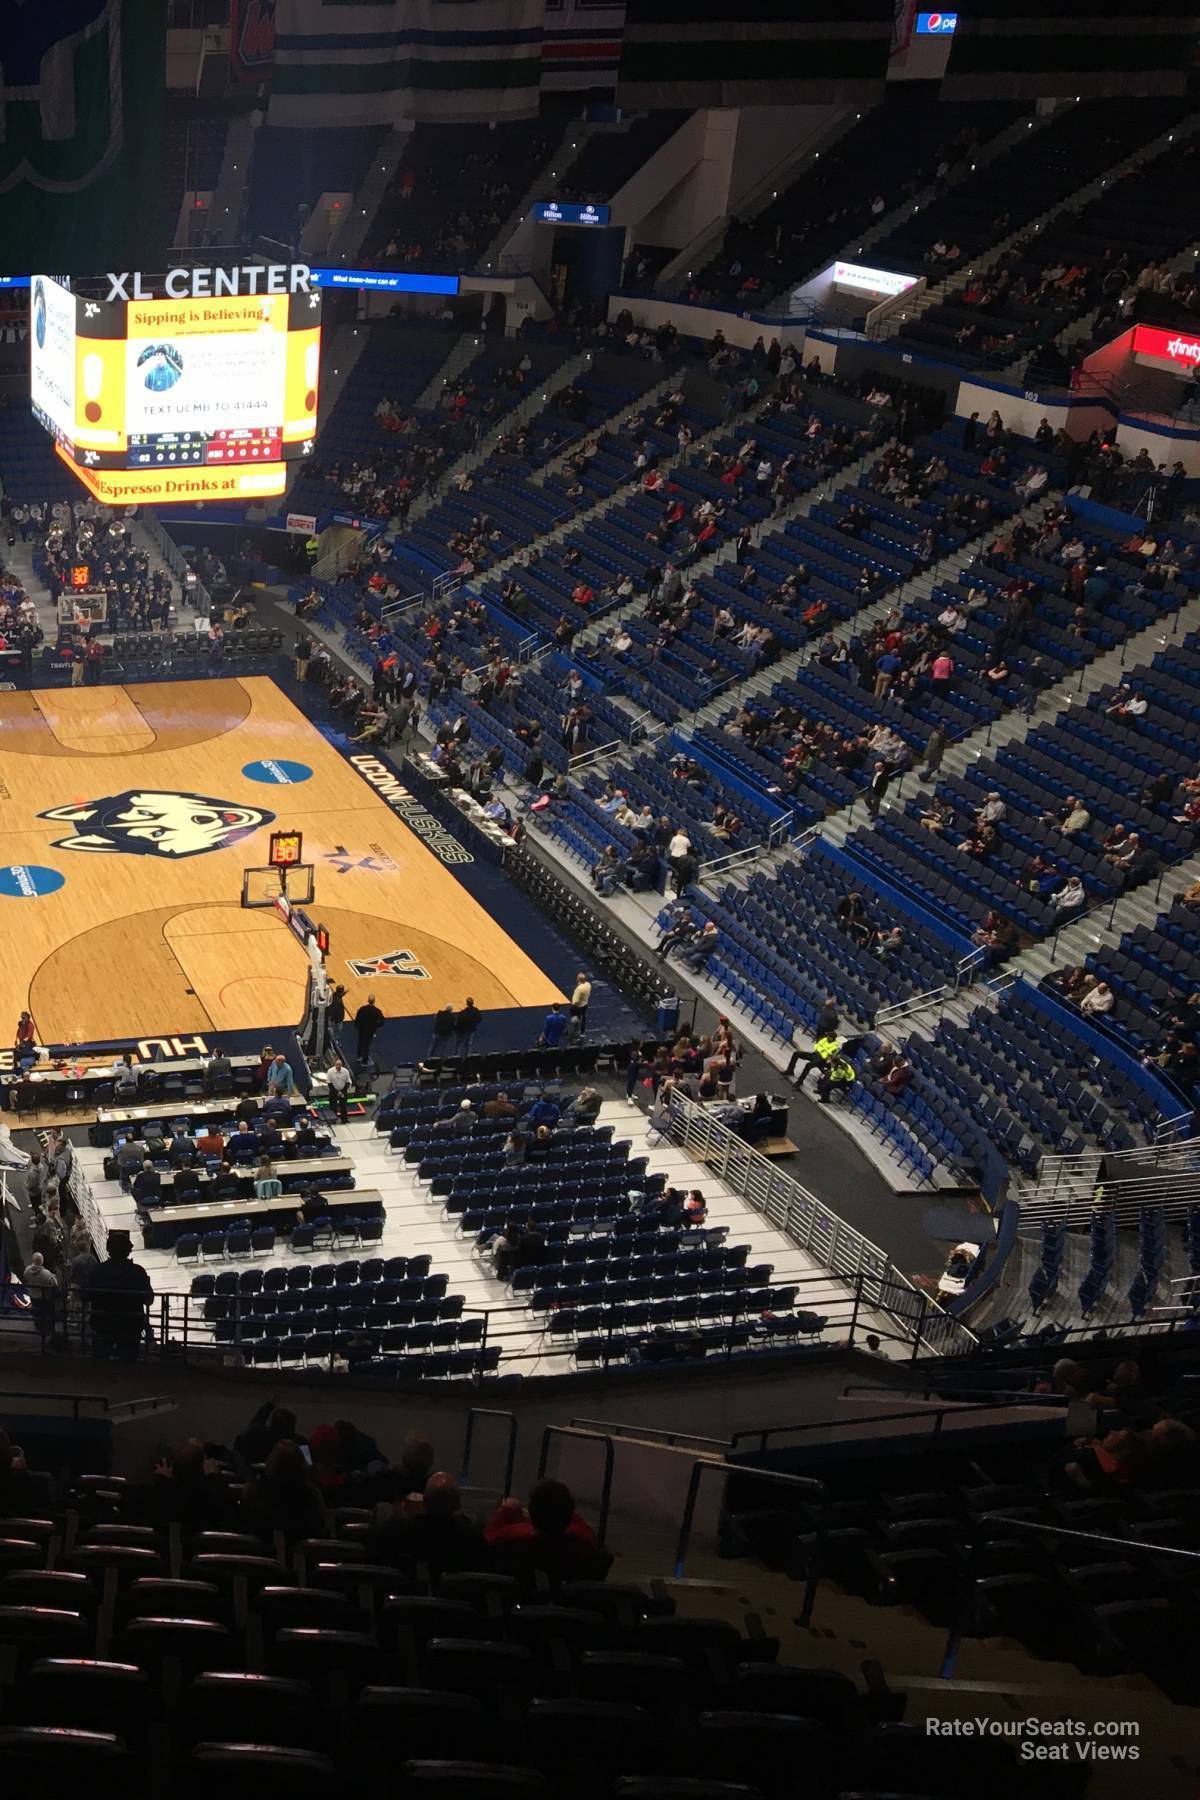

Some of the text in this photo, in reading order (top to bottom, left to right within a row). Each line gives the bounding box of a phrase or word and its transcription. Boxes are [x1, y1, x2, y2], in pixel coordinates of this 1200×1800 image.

[543, 210, 562, 218] Hilton
[580, 213, 599, 221] Hilton
[105, 263, 312, 301] XL CENTER
[134, 311, 186, 326] Sipping
[189, 310, 200, 321] is
[1024, 391, 1039, 401] 103
[143, 400, 268, 415] TEXT UCMB TO 41444
[101, 479, 235, 497] Espresso Drinks at
[74, 574, 87, 585] 30
[350, 754, 474, 864] UCONN HUSKIES
